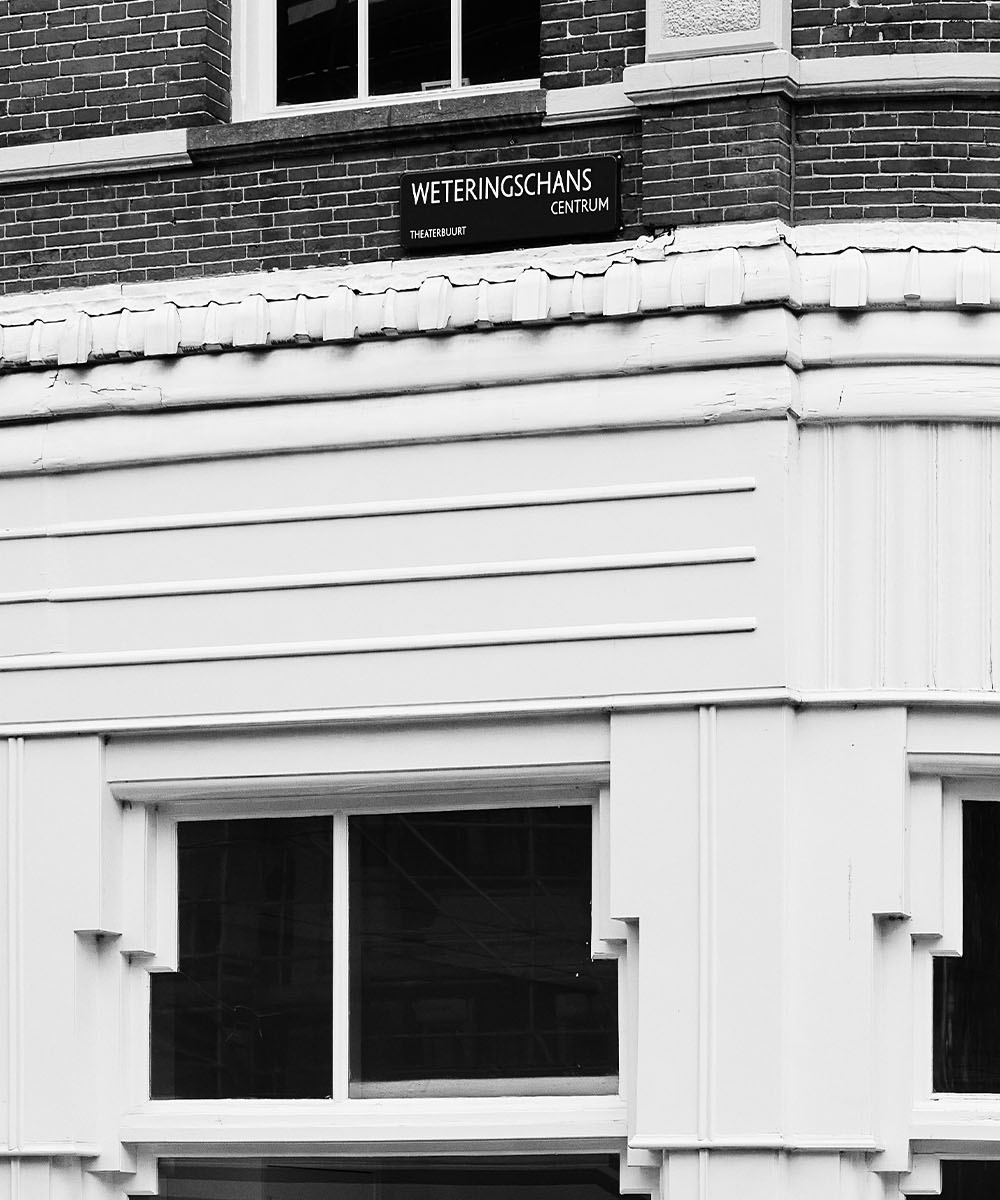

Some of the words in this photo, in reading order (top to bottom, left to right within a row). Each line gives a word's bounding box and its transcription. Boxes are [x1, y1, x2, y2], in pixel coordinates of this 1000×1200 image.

[411, 168, 592, 205] WETERINGSCHANS
[550, 197, 609, 215] CENTRUM
[410, 226, 467, 240] THEATERBUURT
